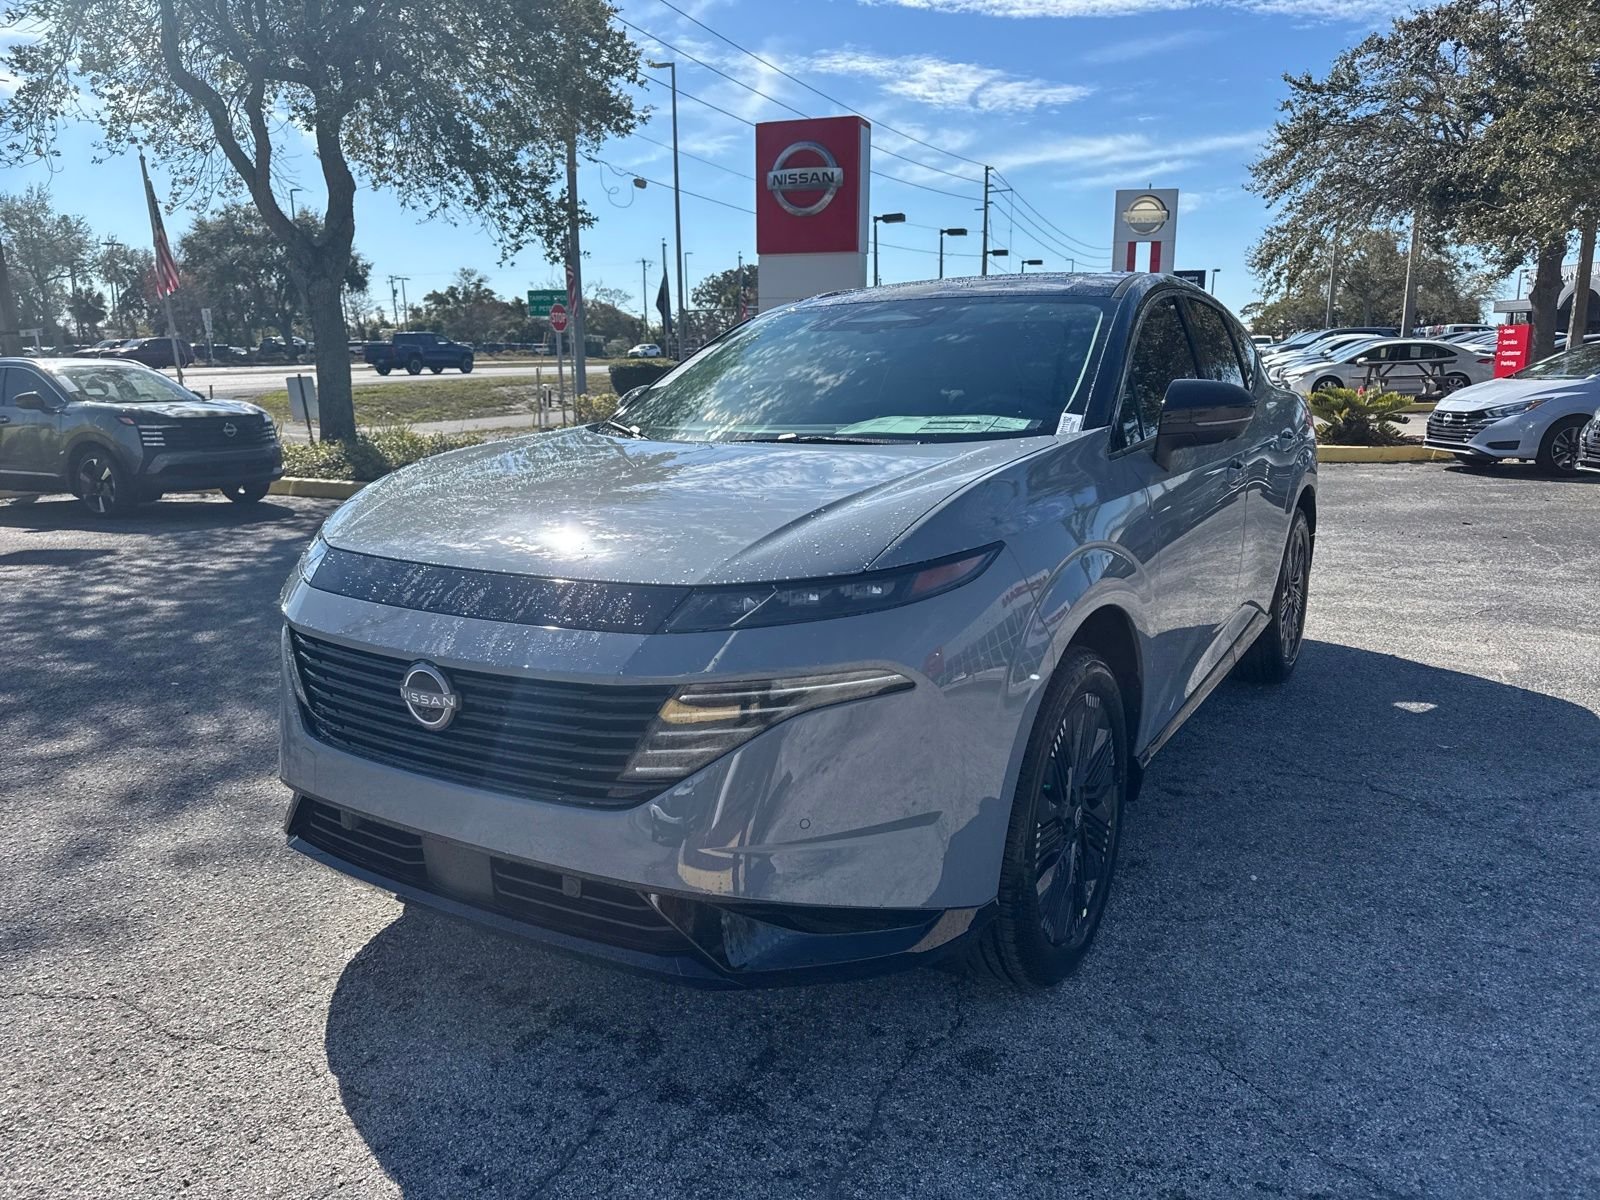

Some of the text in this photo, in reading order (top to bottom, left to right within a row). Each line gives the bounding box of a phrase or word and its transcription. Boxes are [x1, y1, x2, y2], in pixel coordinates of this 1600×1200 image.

[772, 172, 835, 187] NISSAN
[551, 312, 566, 323] STOP
[400, 687, 455, 707] NISSAN
